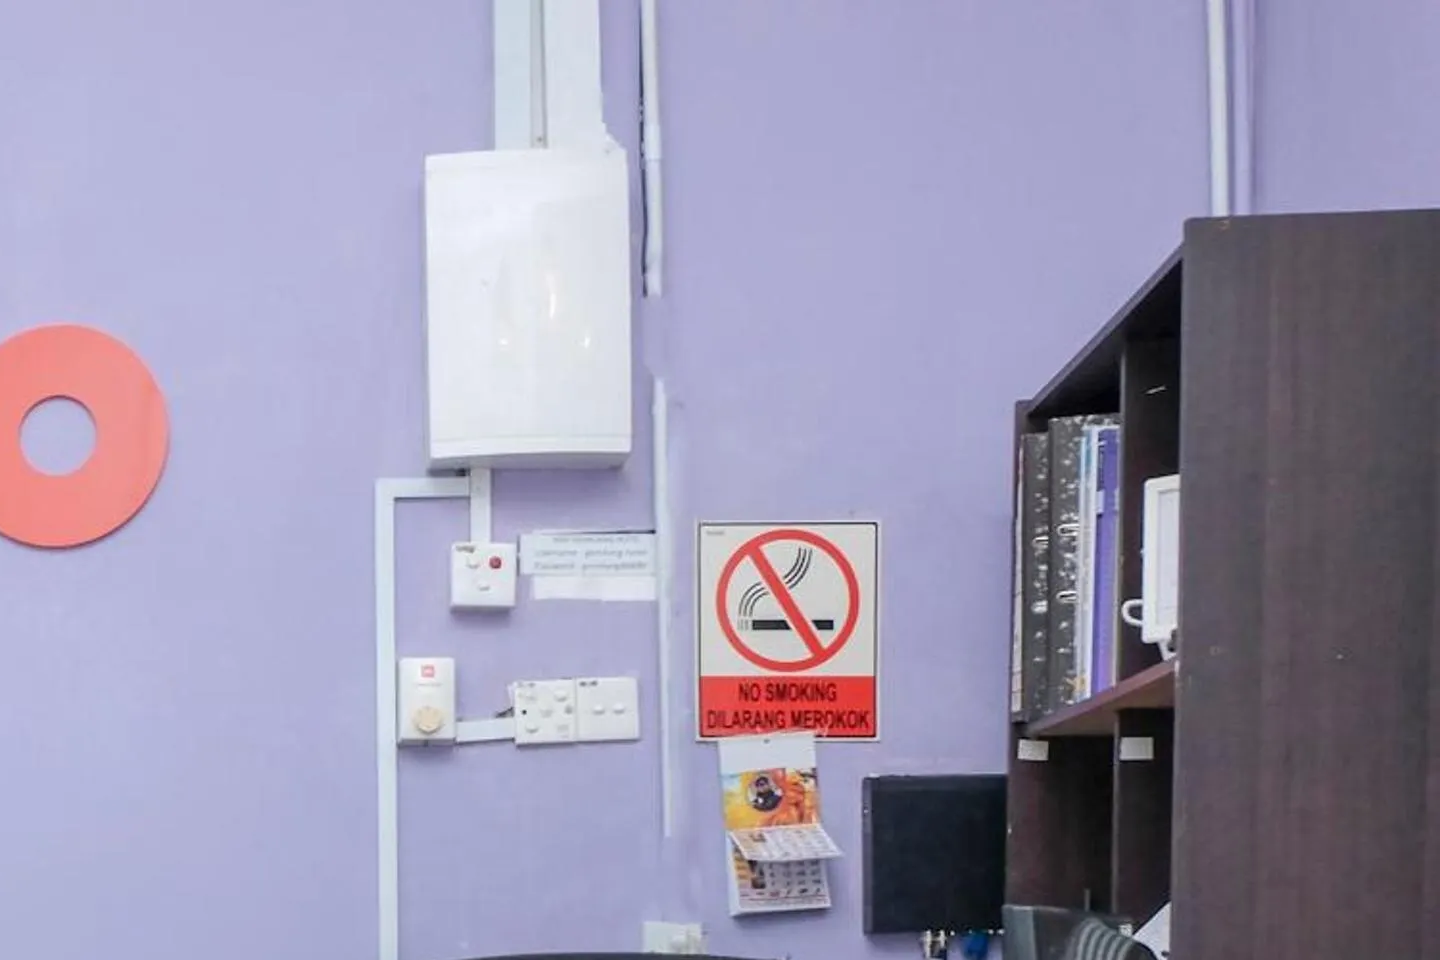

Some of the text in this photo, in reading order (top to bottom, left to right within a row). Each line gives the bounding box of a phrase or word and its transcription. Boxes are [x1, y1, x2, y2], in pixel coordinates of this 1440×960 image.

[738, 683, 837, 701] NO SMOKING
[708, 710, 869, 729] DILARANG MEROKOK
